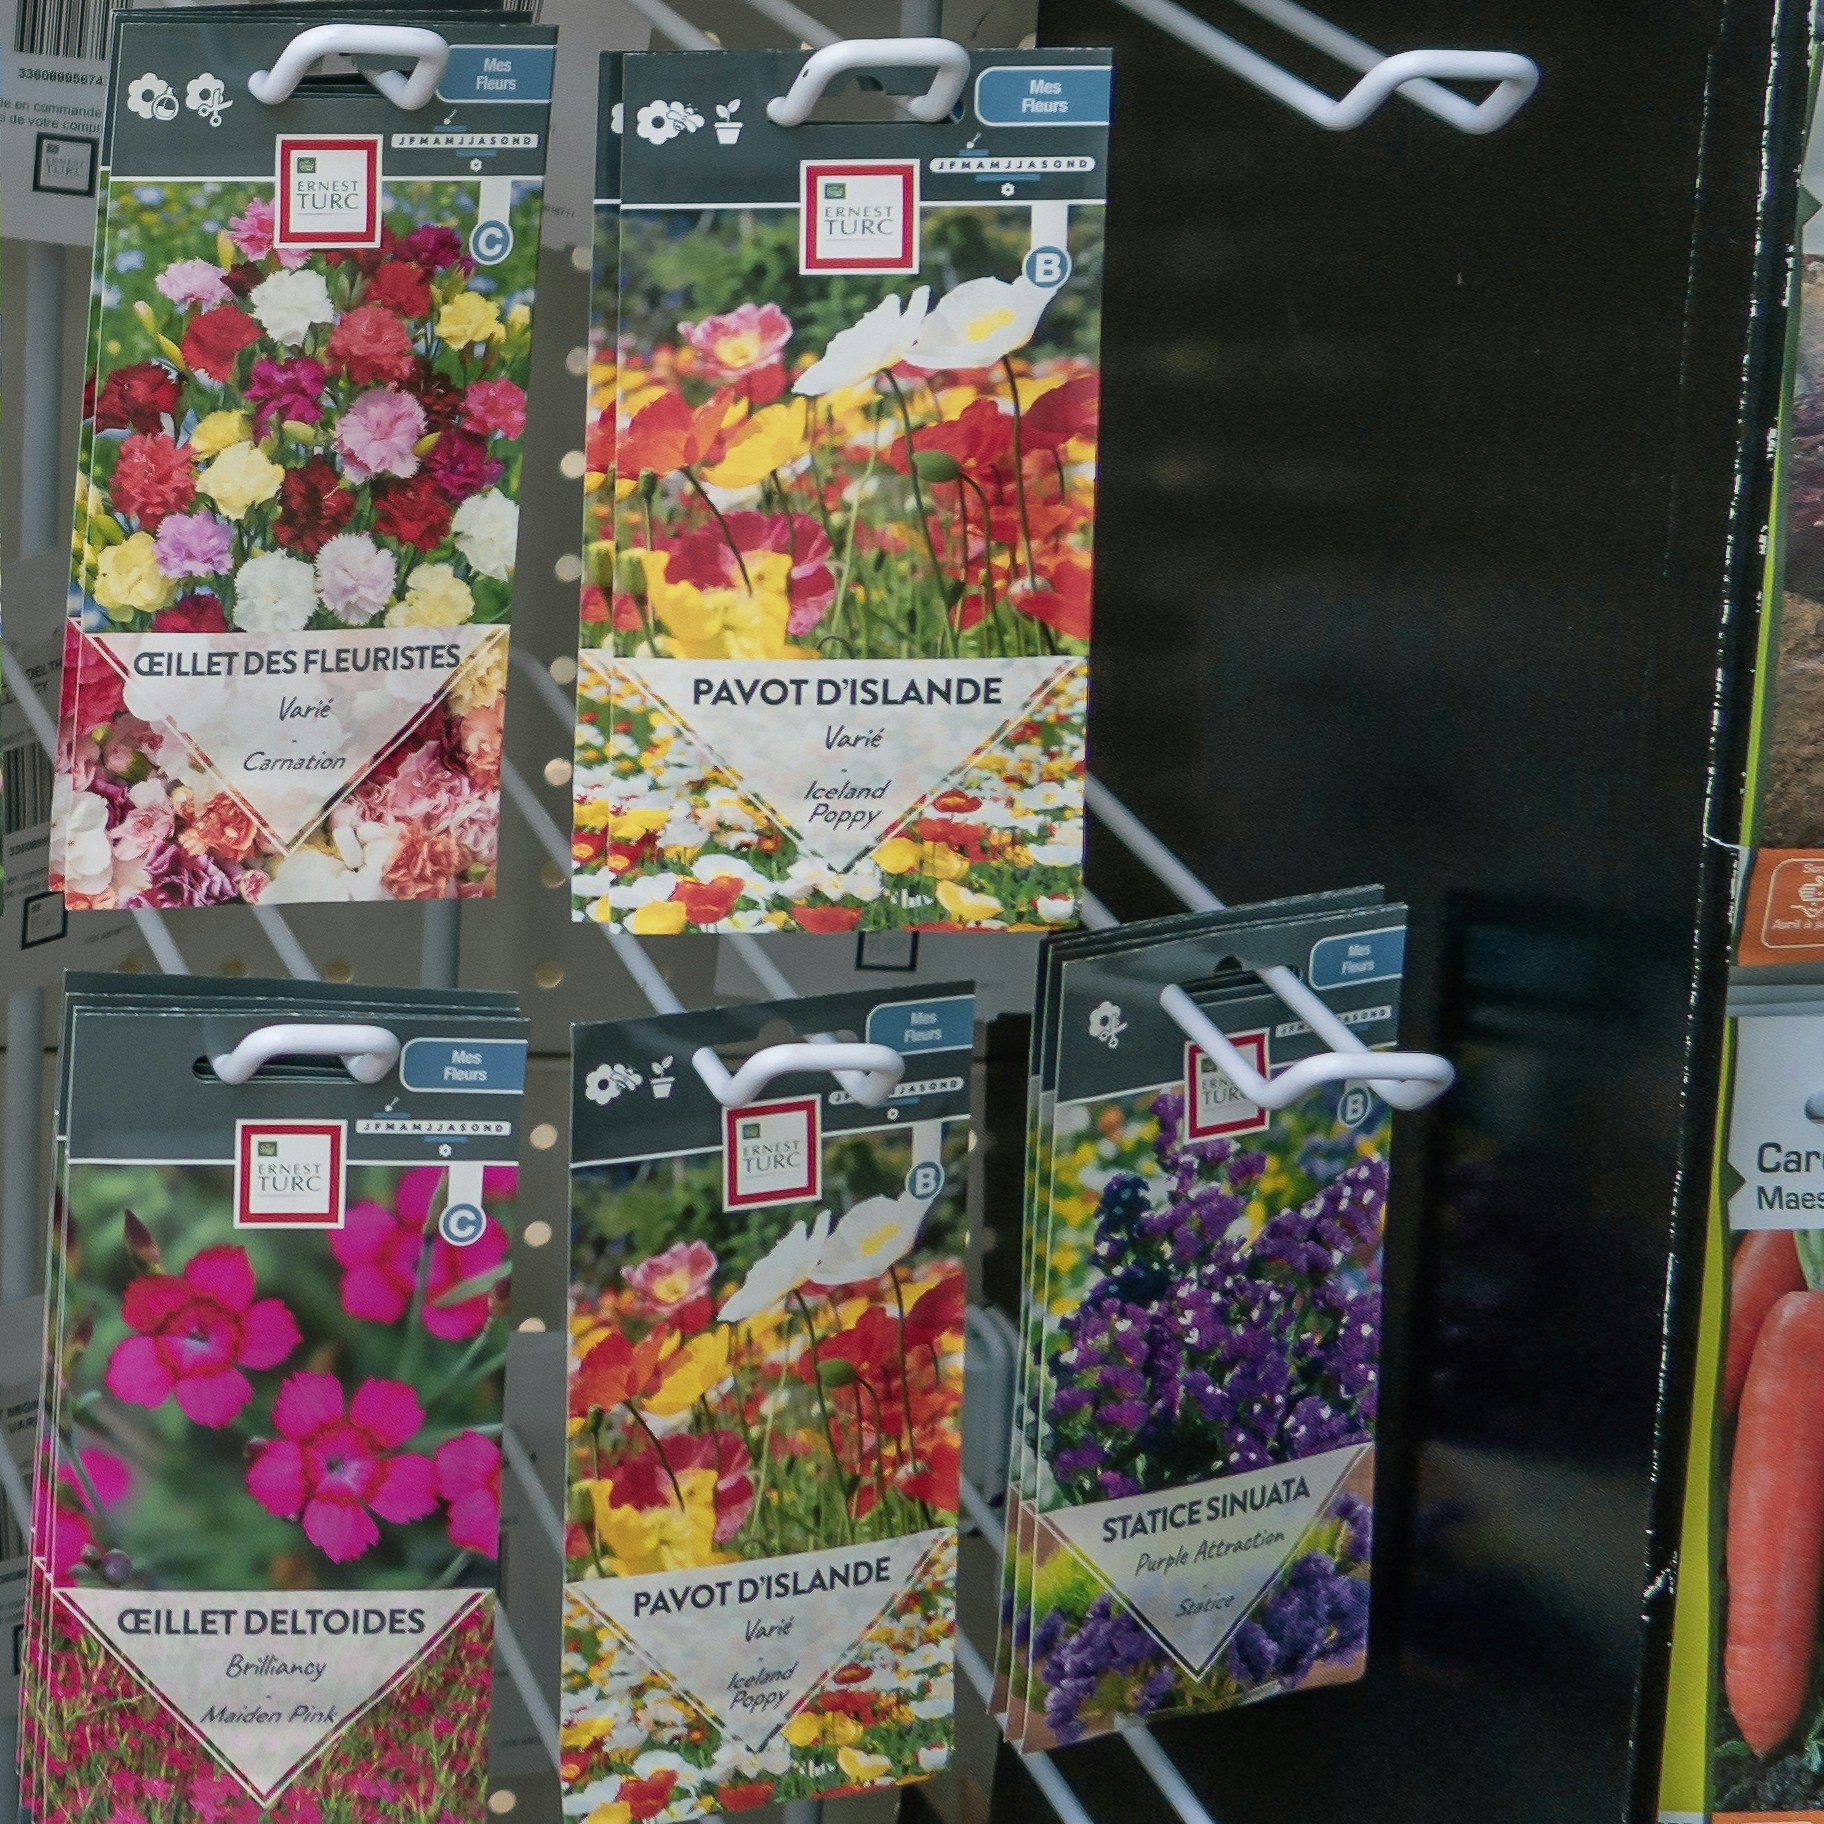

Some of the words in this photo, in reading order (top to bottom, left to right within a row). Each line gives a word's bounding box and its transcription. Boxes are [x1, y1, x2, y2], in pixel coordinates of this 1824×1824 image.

[134, 648, 238, 676] ŒILLET
[244, 646, 298, 674] DES
[304, 643, 461, 673] FLEURISTES
[693, 678, 809, 706] PAVOT
[816, 677, 1001, 706] D'ISLANDE
[825, 726, 883, 751] Varié
[243, 751, 346, 774] Carnation
[1102, 1499, 1202, 1544] STATICE
[1206, 1478, 1311, 1529] SINUATA
[632, 1578, 735, 1618] PAVOT
[738, 1556, 890, 1604] D'ISLANDE
[1175, 1591, 1236, 1619] Statice
[118, 1608, 235, 1636] ŒILLET
[245, 1608, 425, 1635] DELTOIDES
[200, 1704, 283, 1725] Maiden
[291, 1705, 339, 1725] Pink
